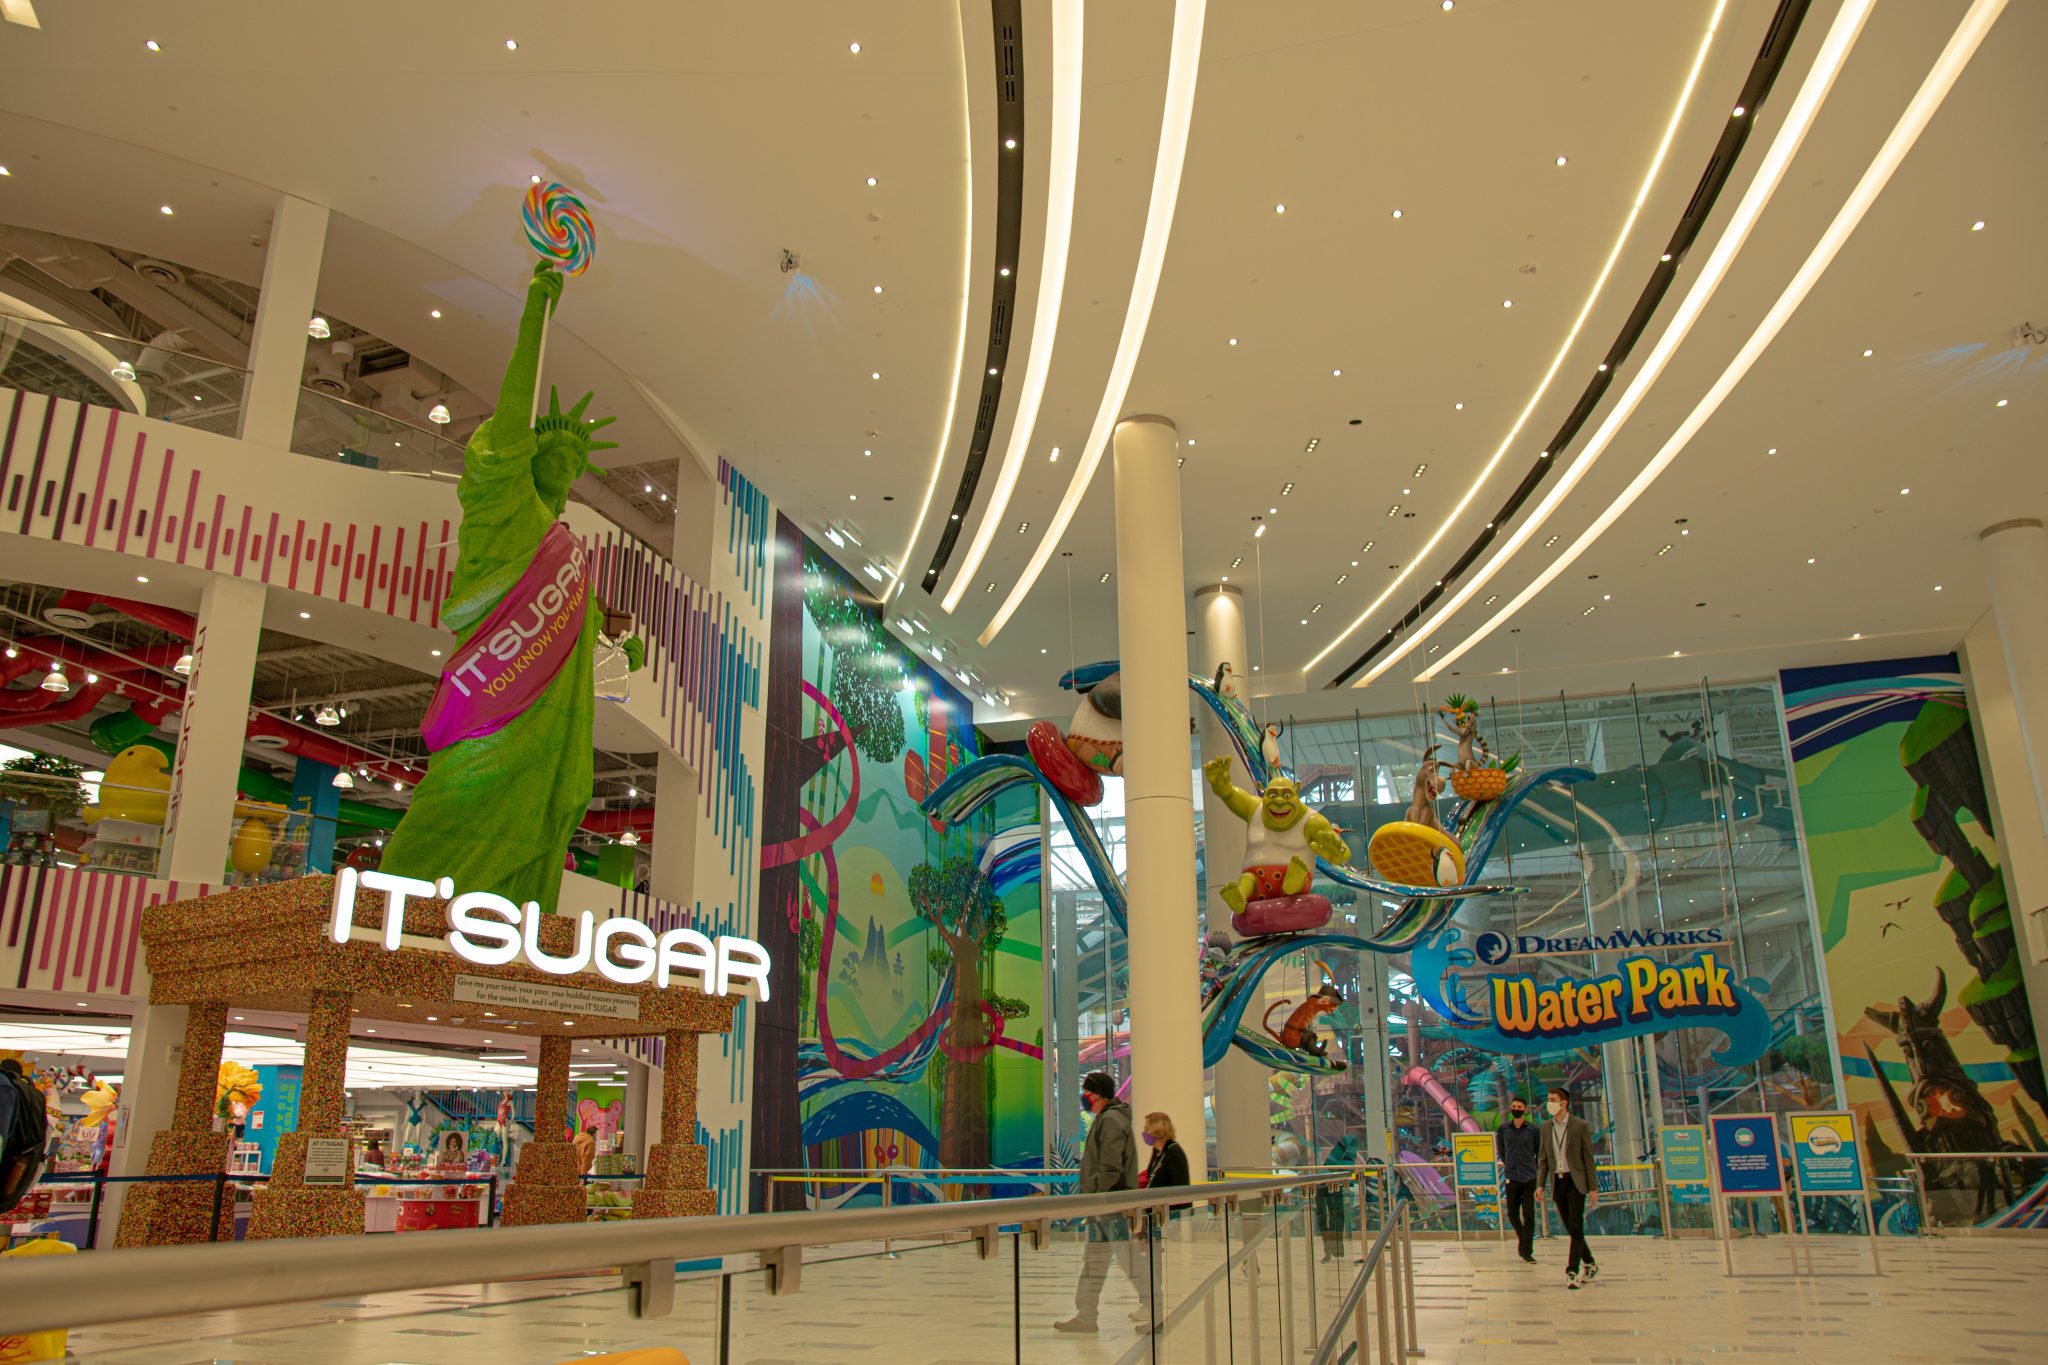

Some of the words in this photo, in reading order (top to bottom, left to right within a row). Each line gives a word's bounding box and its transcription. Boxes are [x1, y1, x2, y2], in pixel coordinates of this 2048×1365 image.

[451, 547, 586, 697] IT'SUGAR
[483, 669, 516, 698] YOU
[513, 630, 553, 673] KNOW
[550, 607, 570, 636] YOU
[330, 866, 771, 1002] IT'SUGAR
[457, 977, 473, 987] Give
[551, 991, 565, 999] your
[566, 991, 591, 1001] huddled
[612, 998, 637, 1008] yearning
[476, 991, 486, 999] for
[487, 992, 499, 1001] the
[500, 995, 518, 1003] sweet
[531, 998, 544, 1006] and
[548, 1000, 559, 1008] will
[559, 1001, 572, 1010] give
[1493, 977, 1622, 1033] Water
[1626, 954, 1736, 1016] Park
